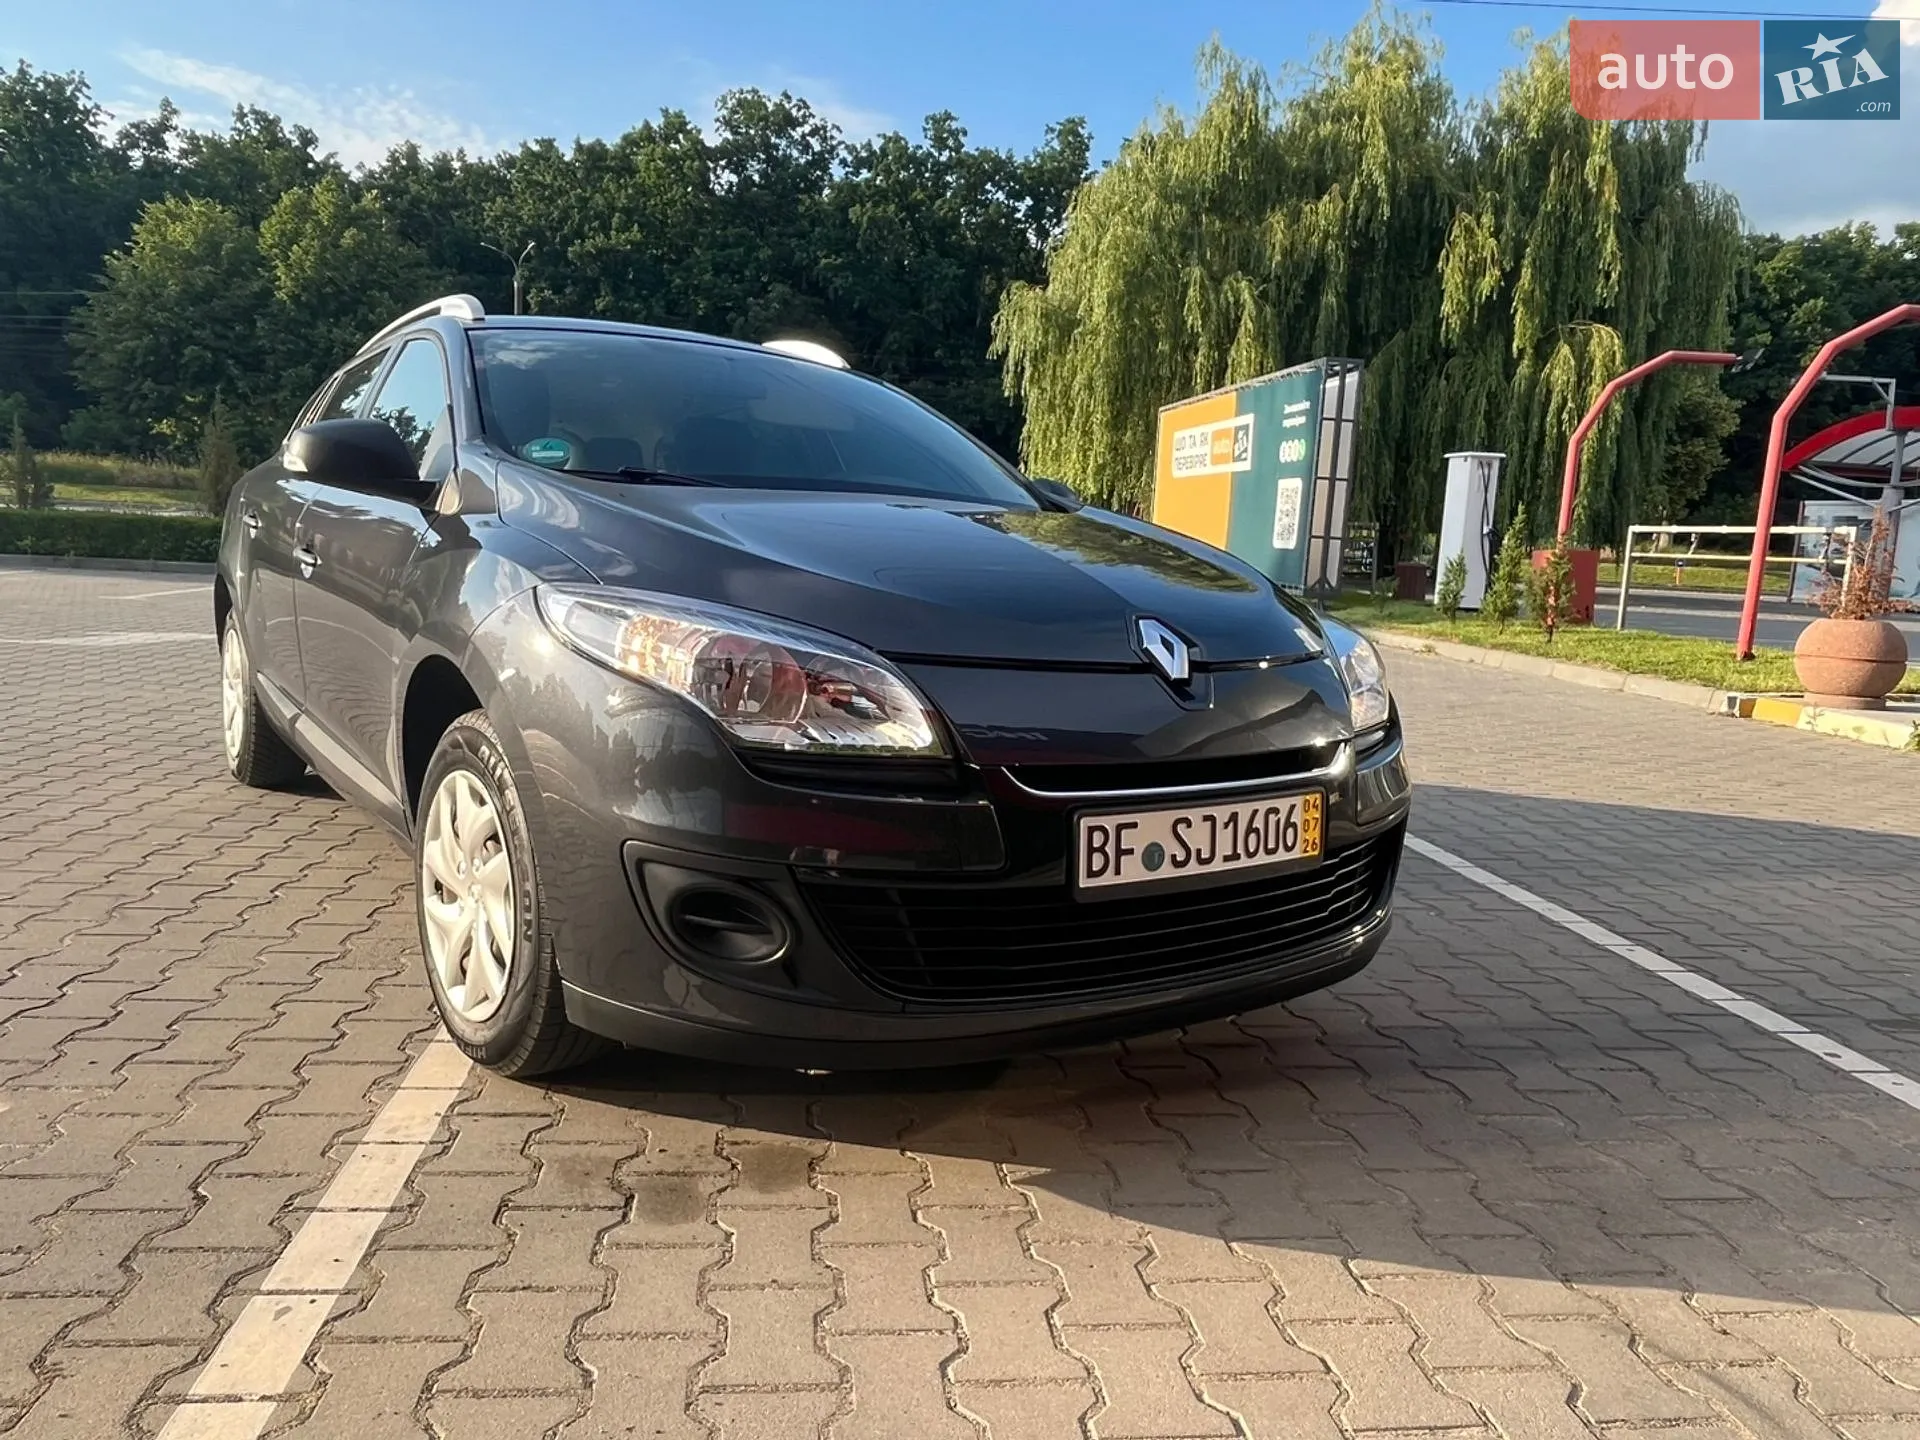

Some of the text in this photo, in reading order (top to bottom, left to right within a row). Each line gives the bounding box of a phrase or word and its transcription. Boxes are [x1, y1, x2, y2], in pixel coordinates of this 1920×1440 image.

[1303, 797, 1320, 814] 04
[1303, 816, 1320, 833] 07
[1086, 820, 1139, 879] BF
[1303, 837, 1319, 854] 26
